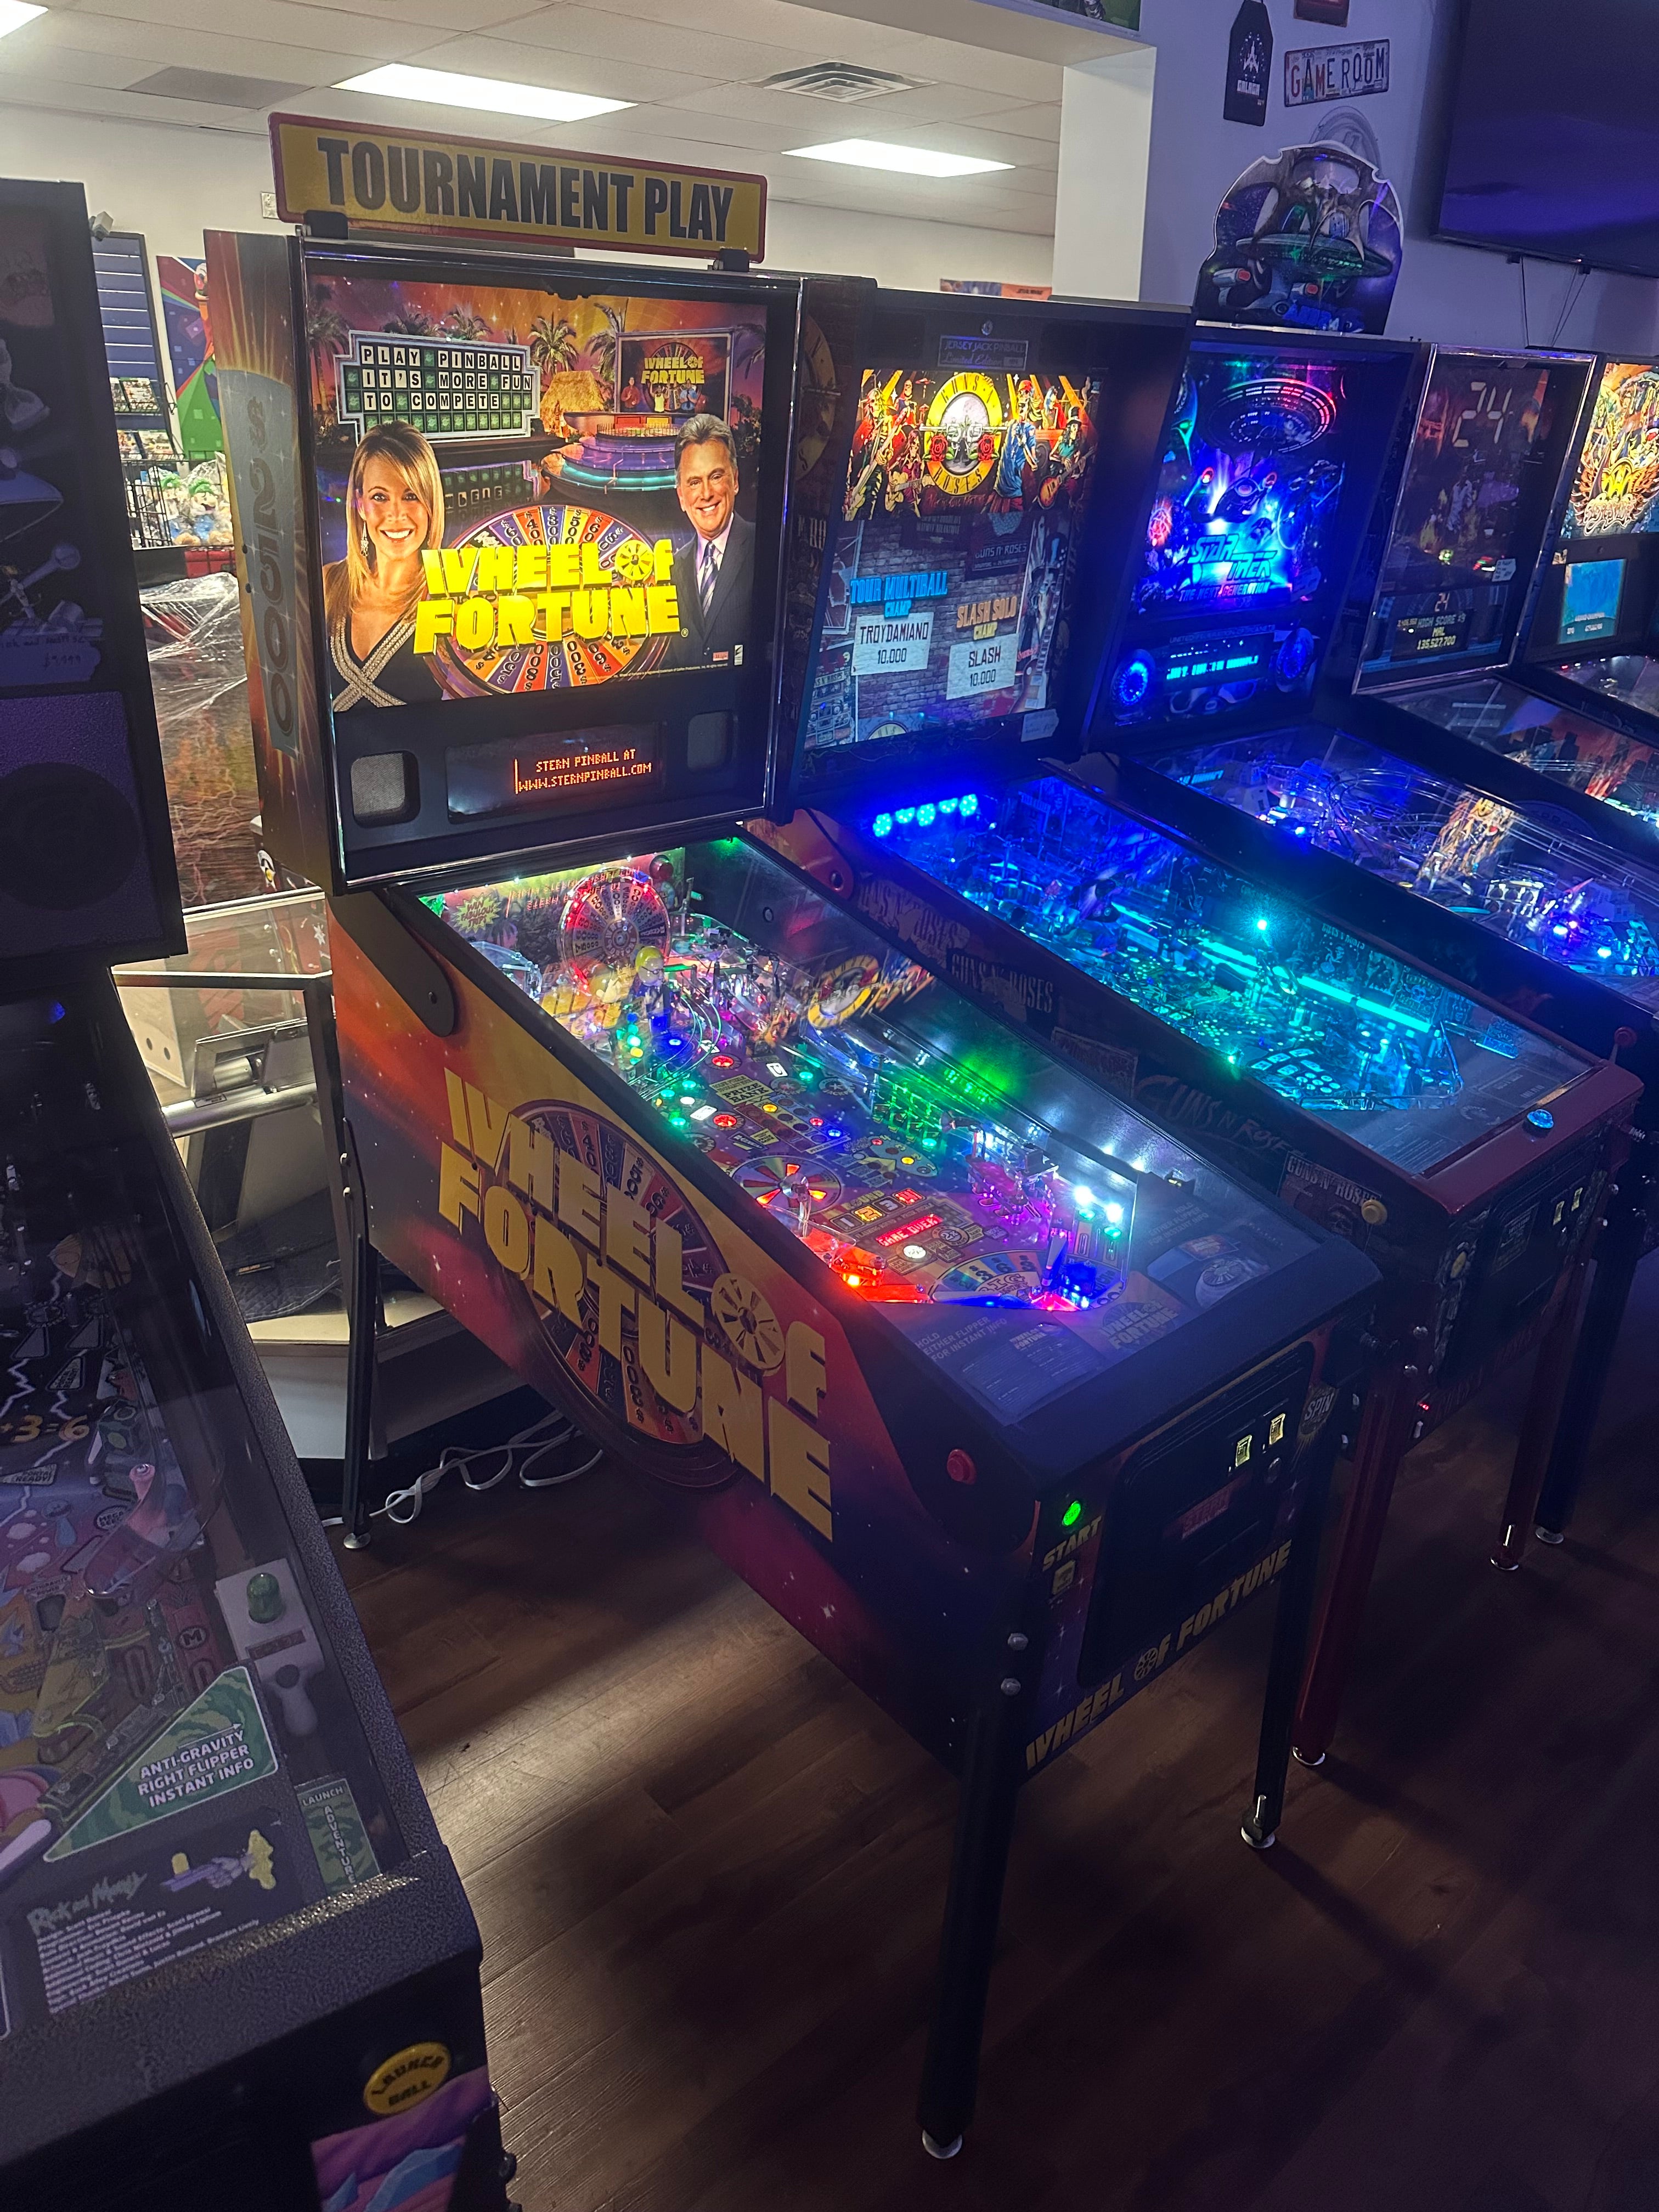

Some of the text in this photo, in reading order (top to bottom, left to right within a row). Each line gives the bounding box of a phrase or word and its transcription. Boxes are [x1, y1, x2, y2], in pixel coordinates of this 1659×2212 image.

[1291, 47, 1385, 98] GAME ROOM
[317, 137, 733, 242] TOURNAMENT PLAY
[364, 348, 520, 369] PLAY PINBALL
[942, 352, 972, 364] Limited
[975, 354, 1003, 367] Edition
[944, 340, 1025, 353] JERSEY JACK PINBALL
[641, 369, 705, 384] FORTUNE
[644, 357, 687, 369] WHEEL
[367, 372, 532, 390] IT'S MORE FUN
[366, 394, 498, 408] TO COMPETE
[1452, 381, 1513, 448] 24
[934, 468, 983, 494] ROSES
[1004, 543, 1028, 555] ROSES
[1188, 534, 1278, 581] STAR TREK
[421, 539, 674, 597] WHEEL OF
[850, 572, 948, 604] TOUR MULTIBALL
[1179, 589, 1196, 602] THE
[1222, 582, 1271, 597] GENERATION
[1435, 592, 1450, 612] 24
[413, 586, 681, 656] FORTUNE
[884, 599, 912, 618] CHAMP
[956, 596, 1018, 628] SLASH SOLO
[968, 646, 1001, 668] SLASH
[536, 748, 636, 772] STERN PINBALL AT
[518, 762, 652, 793] WWW.STERNPINBALL.COM
[461, 904, 495, 921] FABULOUS
[467, 901, 484, 912] WIN
[468, 915, 487, 928] TRIPS
[951, 953, 986, 992] GUNS
[1009, 970, 1054, 1014] ROSES
[723, 1082, 762, 1098] PRIZE
[729, 1087, 769, 1103] BANK
[1287, 1155, 1318, 1184] GUNS
[857, 1207, 877, 1220] 2
[879, 1199, 899, 1211] 3
[444, 1068, 826, 1418] WHEEL OF
[878, 1229, 909, 1246] GAME
[910, 1216, 939, 1234] OVER
[923, 1316, 989, 1357] EITHER FLIPPER
[1101, 1311, 1144, 1338] WHEEL
[1108, 1306, 1179, 1350] FORTUNE
[438, 1142, 833, 1543] FORTUNE
[916, 1331, 940, 1350] HOLD
[931, 1317, 1008, 1362] FOR INSTANT INFO
[1304, 1392, 1335, 1421] SPIN
[12, 1414, 90, 1442] 3 6
[15, 1473, 51, 1482] READY!
[1065, 1506, 1080, 1522] START
[1043, 1516, 1102, 1571] START
[1176, 1539, 1292, 1650] FORTUNE
[1026, 1673, 1124, 1770] WHEEL
[140, 1729, 245, 1780] ANTI-GRAVITY
[137, 1743, 251, 1797] RIGHT FLIPPER
[149, 1757, 255, 1808] INSTANT INFO
[301, 1785, 345, 1808] LAUNCH
[323, 1805, 358, 1885] ADVENTURE
[371, 2055, 445, 2096] LAUNCH
[388, 2080, 432, 2108] BALL
